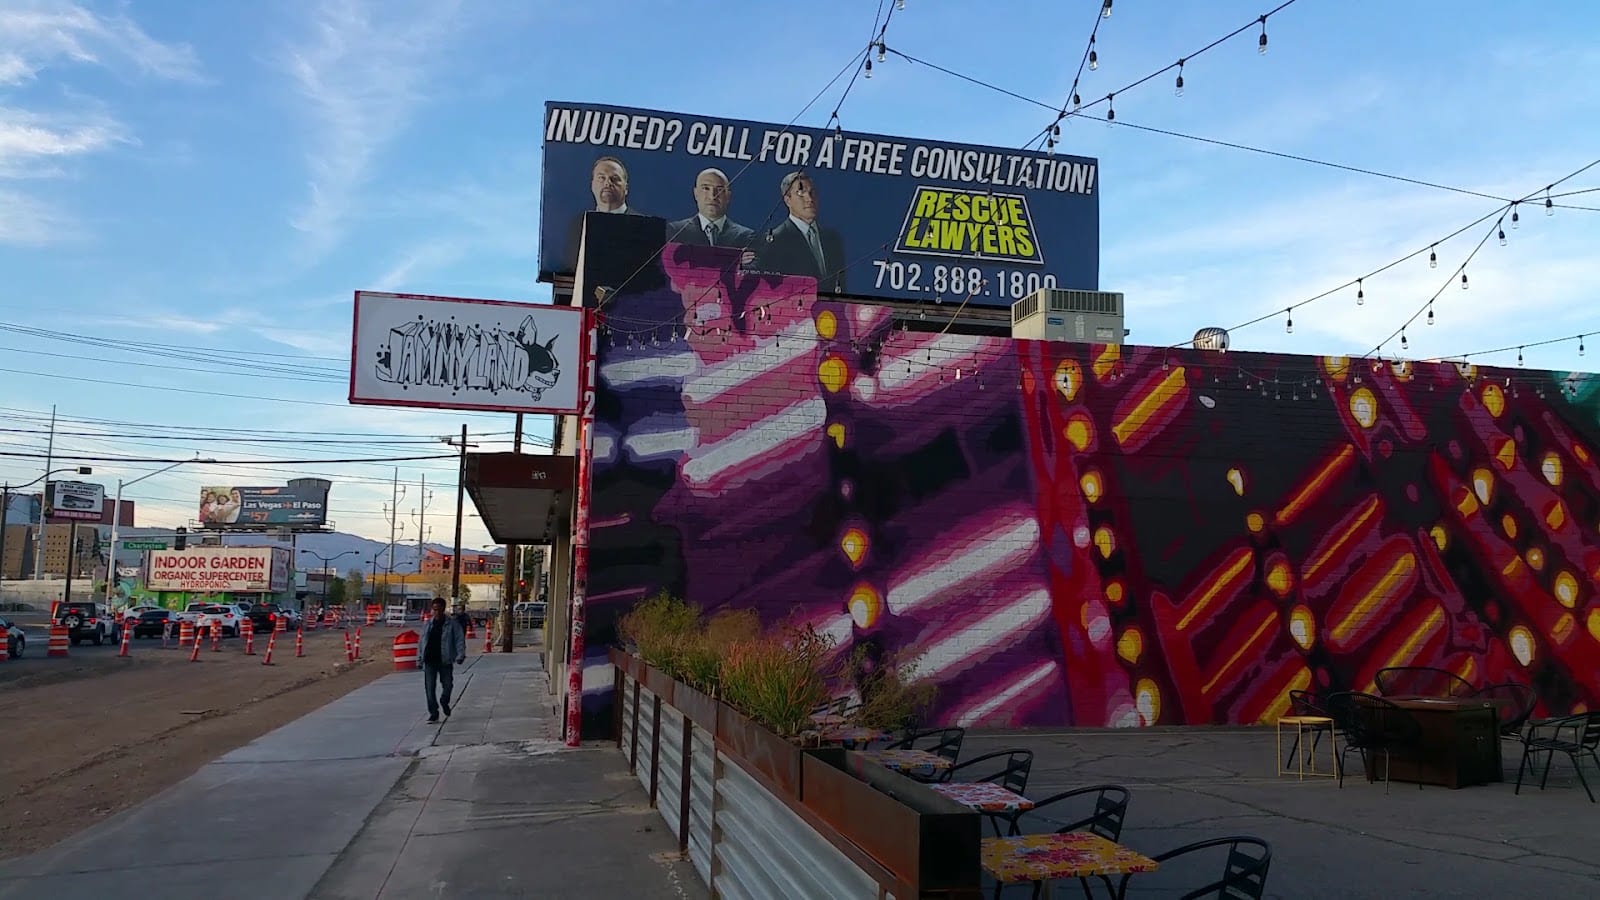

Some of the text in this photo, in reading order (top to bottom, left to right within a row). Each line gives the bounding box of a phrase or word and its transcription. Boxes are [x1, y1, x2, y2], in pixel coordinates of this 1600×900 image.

[546, 108, 1096, 195] INJURED? CALL FOR A FREE CONSULTATION!
[914, 190, 1028, 227] RESCUE
[904, 218, 1035, 257] LAWYERS
[375, 321, 530, 391] JAMMYLAND
[583, 327, 598, 451] 1121
[243, 501, 257, 509] Las
[258, 501, 283, 510] Vegas
[293, 501, 301, 509] El
[154, 556, 265, 569] INDOOR GARDEN
[154, 571, 264, 582] ORGANIC SUPERCENTER
